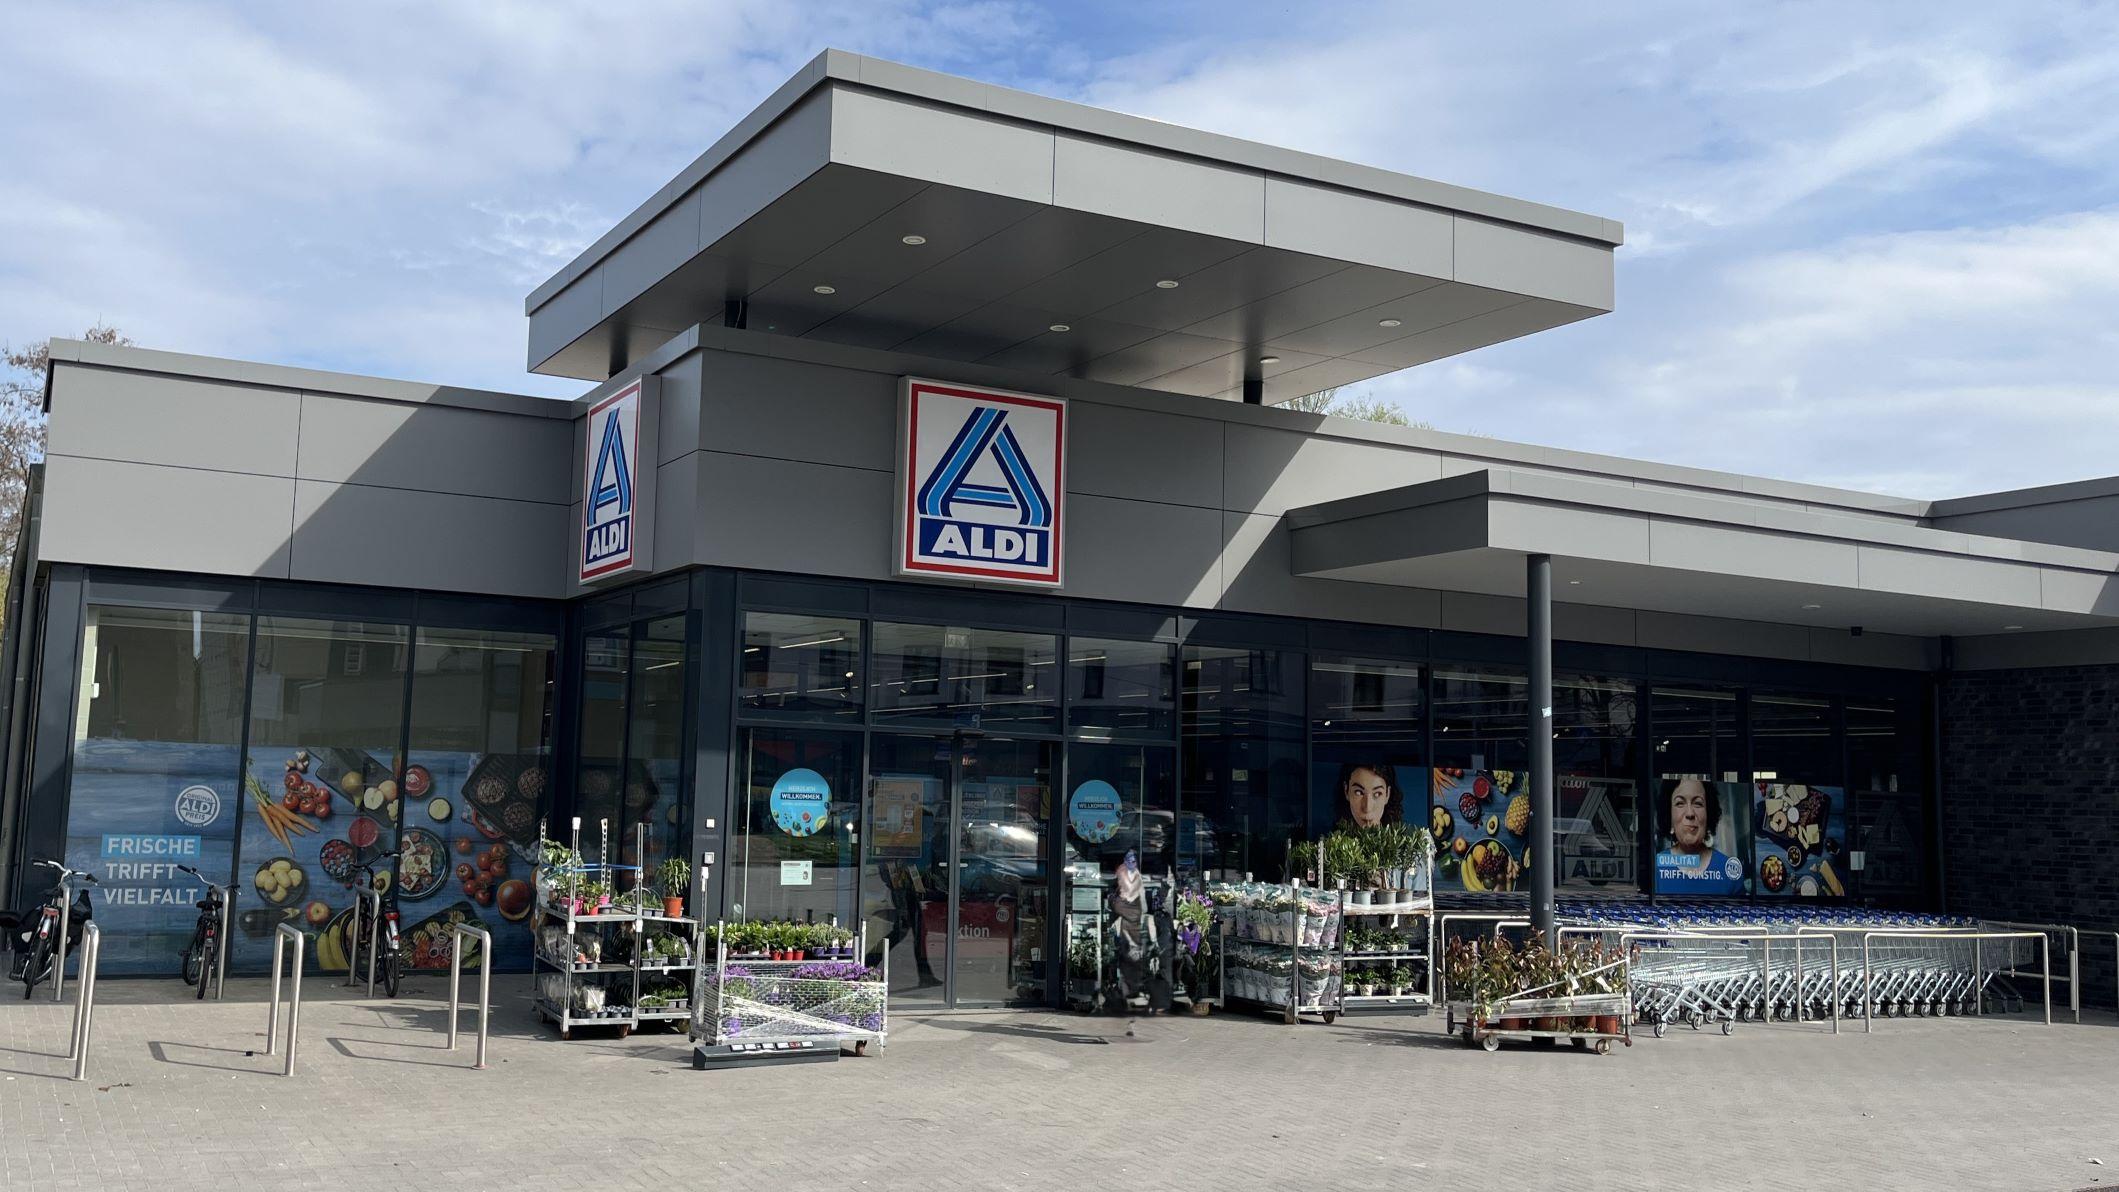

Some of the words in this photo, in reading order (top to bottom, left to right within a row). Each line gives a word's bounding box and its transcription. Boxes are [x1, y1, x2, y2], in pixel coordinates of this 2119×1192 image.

[588, 520, 626, 561] ALDI
[931, 523, 1039, 563] ALDI
[180, 798, 216, 815] ALDI
[185, 811, 206, 821] PREIS
[107, 837, 196, 855] FRISCHE
[105, 863, 178, 880] TRIFFT
[1571, 859, 1625, 879] ALDI
[1659, 869, 1686, 880] TRIFFT
[104, 888, 199, 905] VIELFALT
[958, 923, 990, 938] ktion
